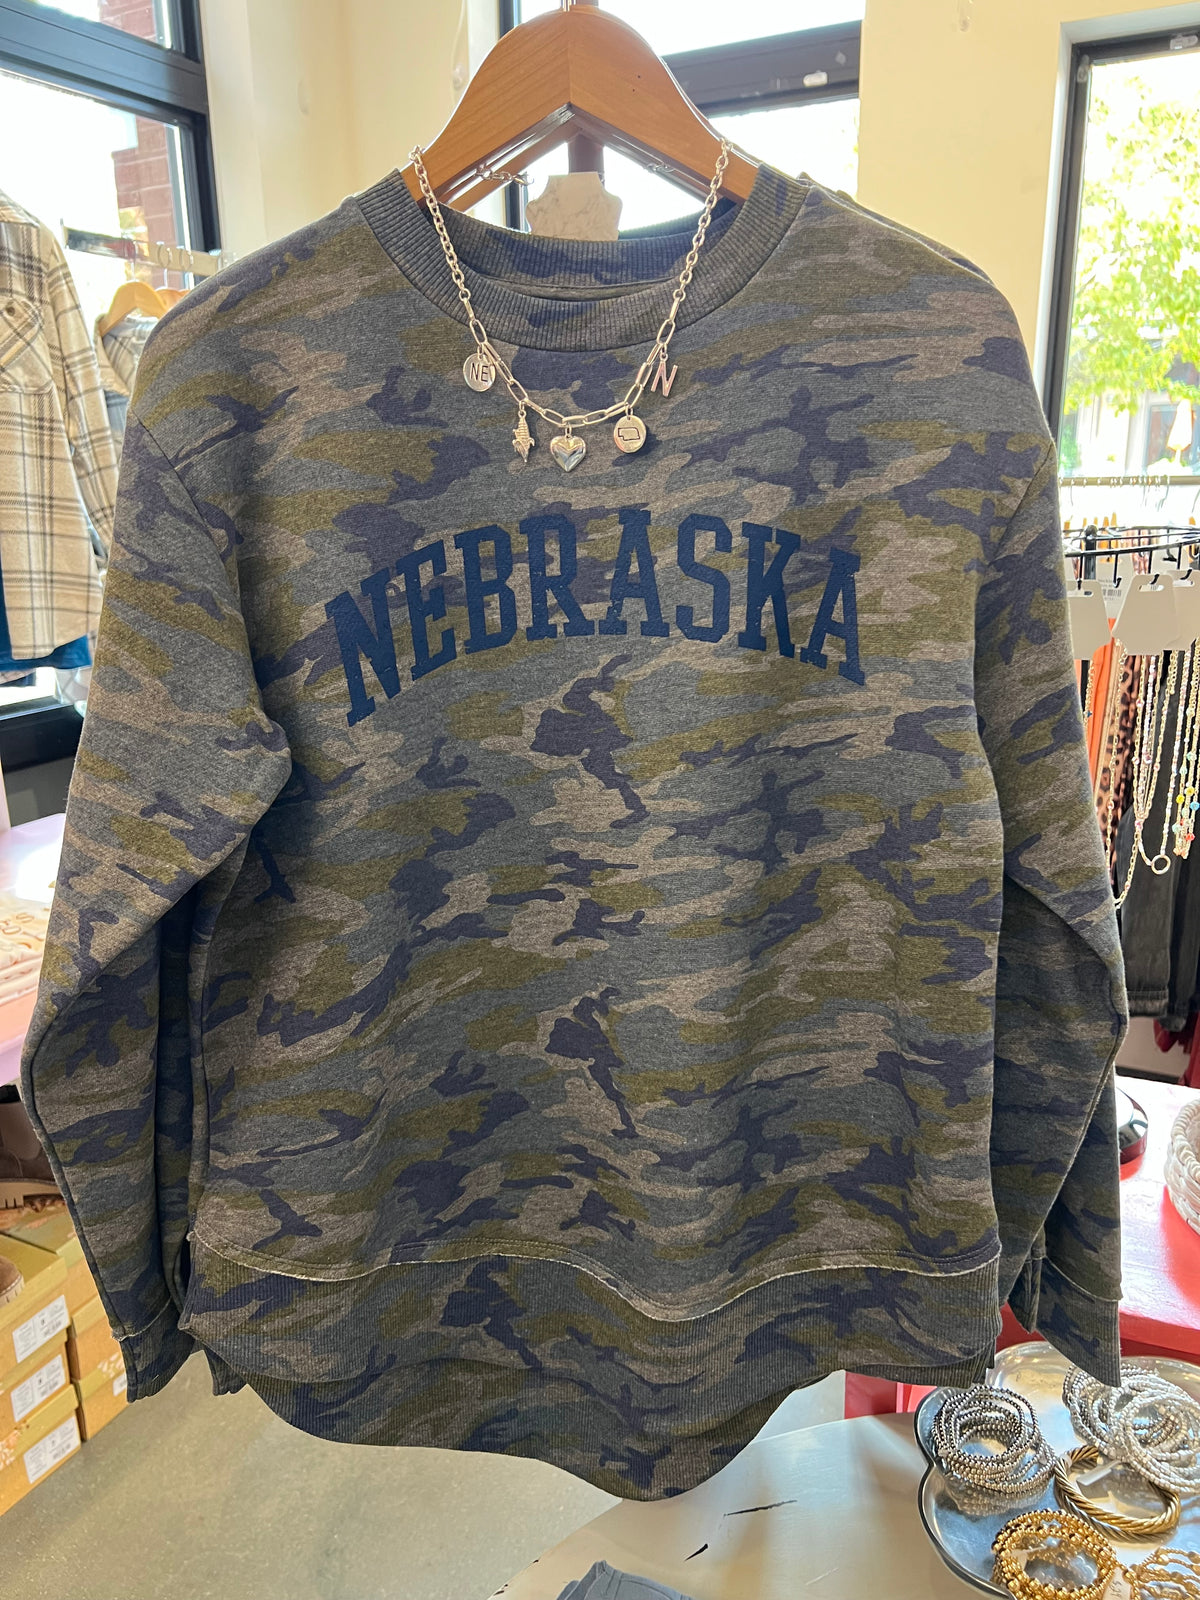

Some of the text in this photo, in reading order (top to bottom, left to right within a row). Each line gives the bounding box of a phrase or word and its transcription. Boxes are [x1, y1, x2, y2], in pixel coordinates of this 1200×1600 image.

[470, 362, 489, 382] NE
[650, 361, 678, 397] N
[324, 509, 865, 727] NEBRASKA
